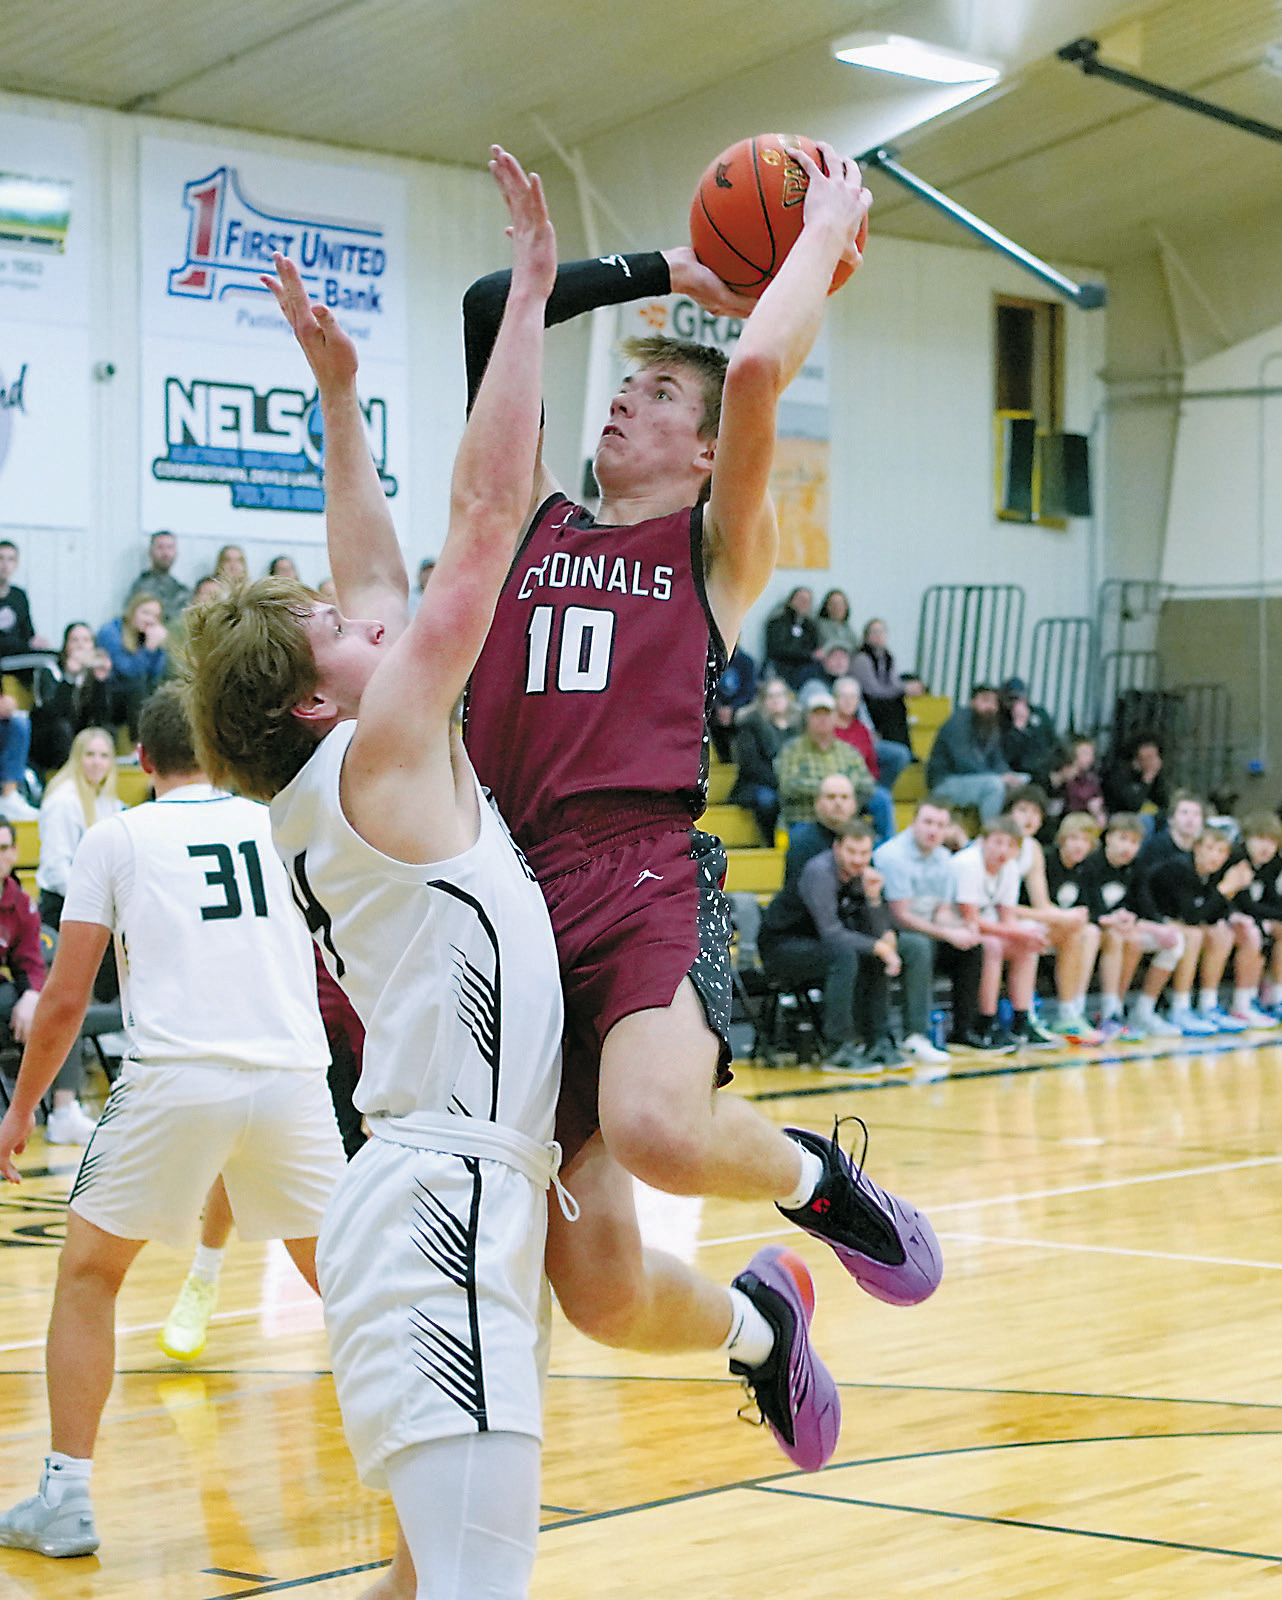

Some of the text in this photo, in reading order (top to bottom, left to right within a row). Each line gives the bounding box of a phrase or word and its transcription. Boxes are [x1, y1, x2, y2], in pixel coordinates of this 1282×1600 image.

[225, 219, 386, 277] FIRST UNITED
[325, 279, 382, 314] Bank
[517, 552, 674, 600] CRDINALS
[524, 604, 616, 695] 10
[187, 840, 268, 920] 31
